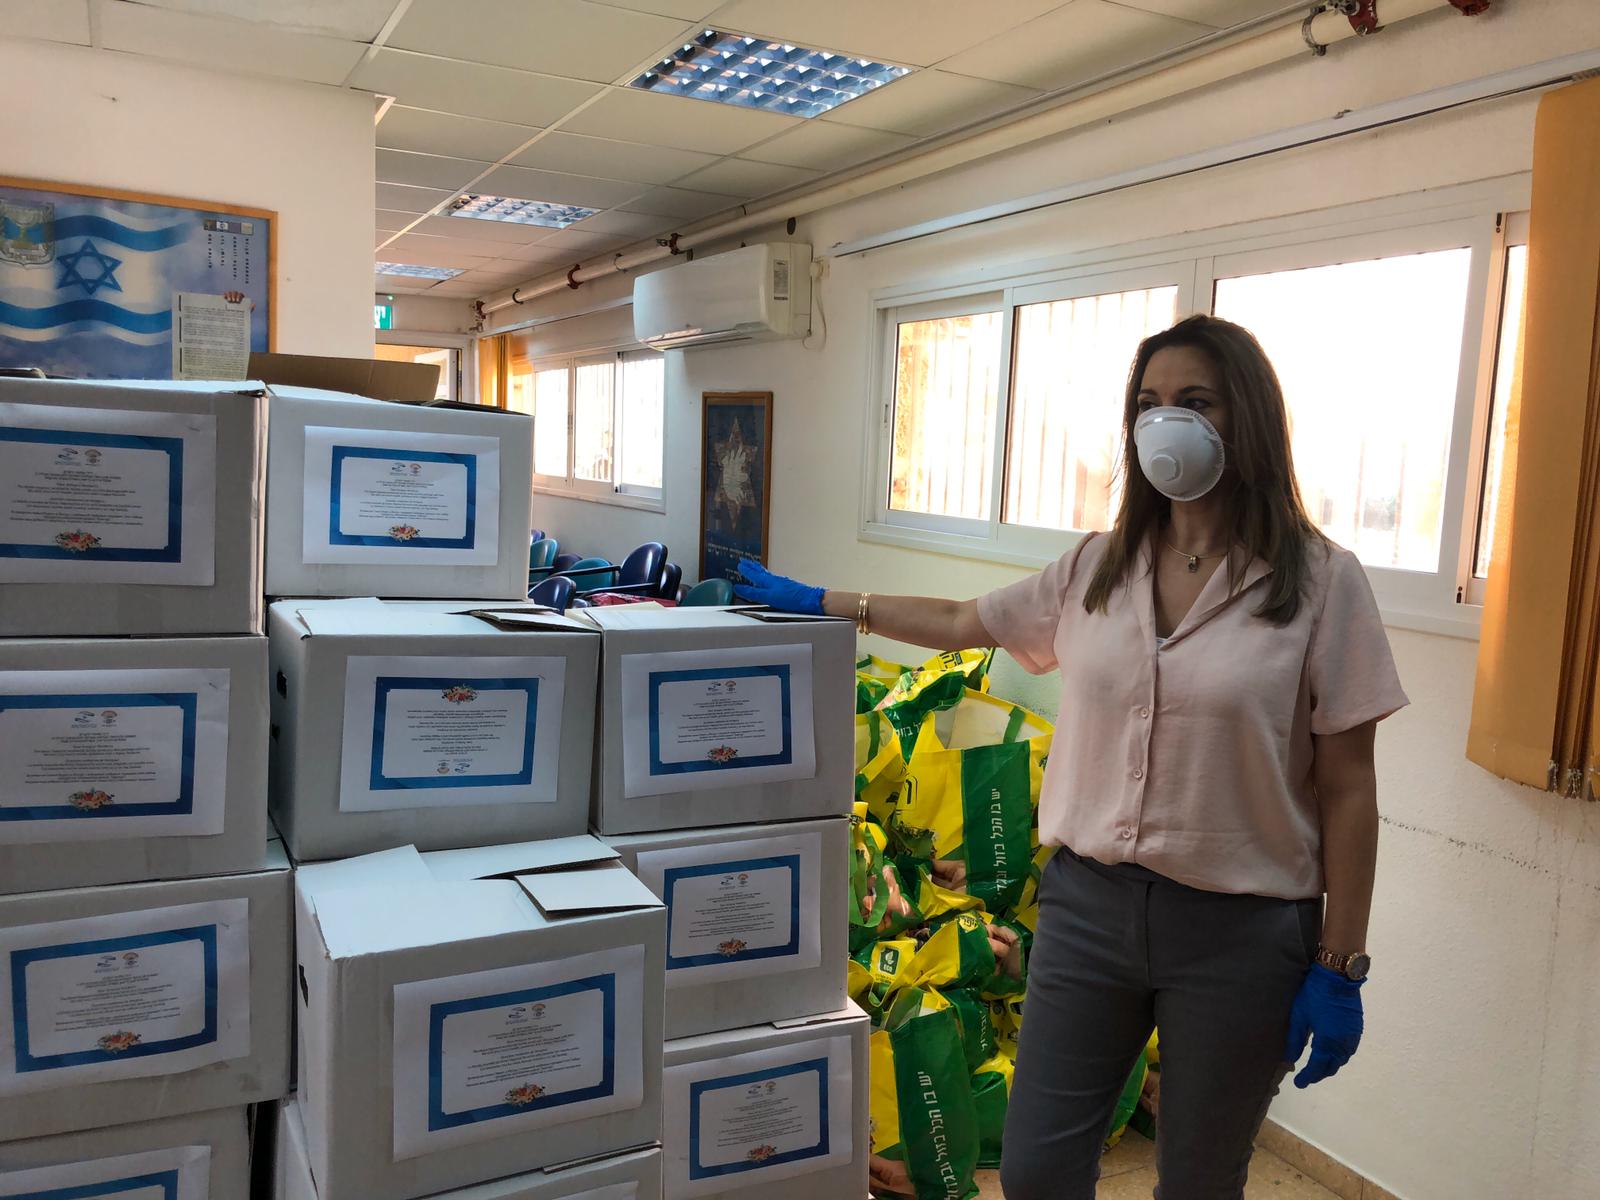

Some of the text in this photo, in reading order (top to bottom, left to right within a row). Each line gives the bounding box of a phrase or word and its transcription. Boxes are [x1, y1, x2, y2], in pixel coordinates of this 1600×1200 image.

[991, 788, 1000, 800] יש
[991, 803, 1001, 814] בו
[990, 818, 1004, 838] הכל
[993, 843, 1007, 866] בזול
[883, 964, 893, 972] ECO
[917, 1071, 932, 1086] יש
[923, 1089, 938, 1104] בו
[928, 1109, 944, 1134] הכל
[933, 1134, 948, 1161] בזול
